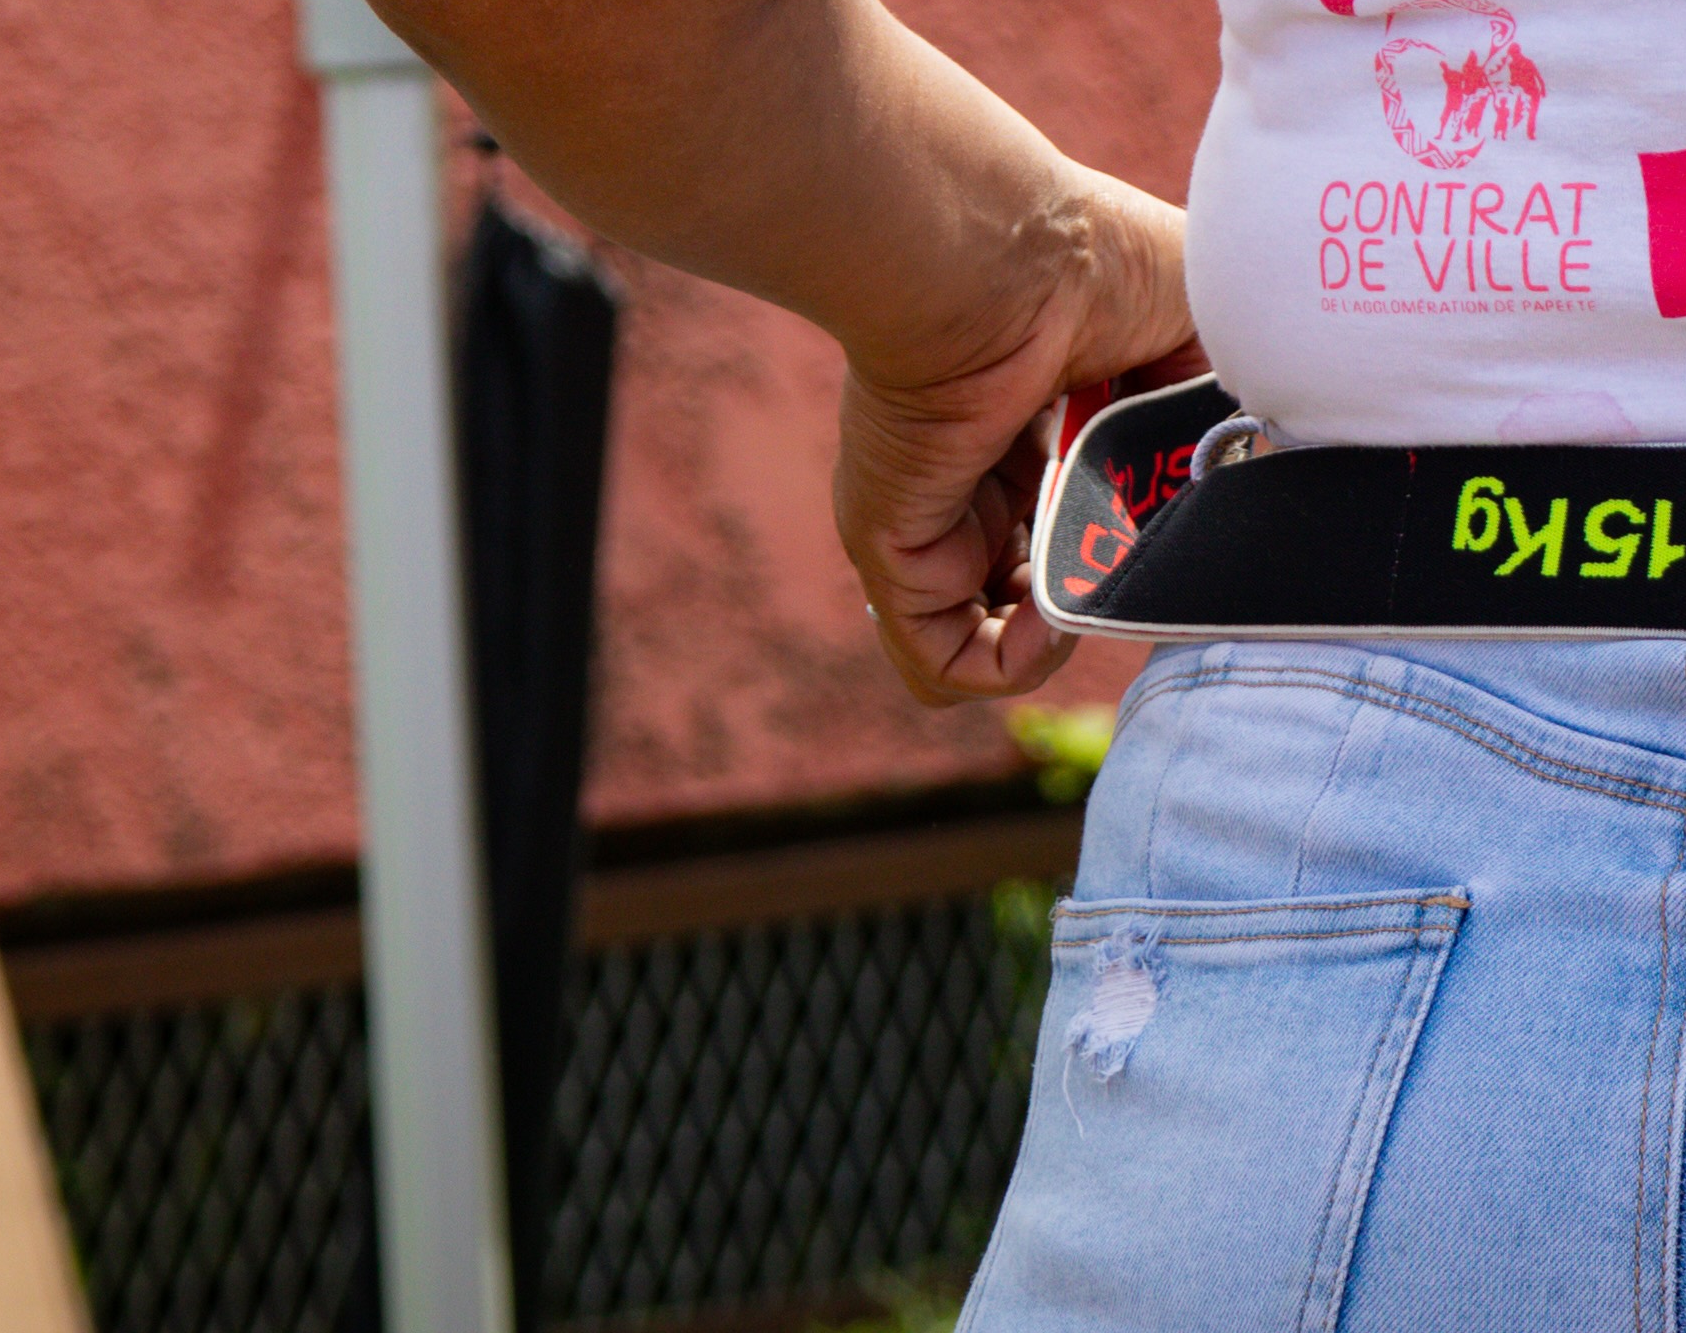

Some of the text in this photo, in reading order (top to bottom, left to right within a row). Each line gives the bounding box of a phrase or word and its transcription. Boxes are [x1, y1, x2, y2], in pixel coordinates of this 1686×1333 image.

[1319, 180, 1598, 236] CONTRAT
[1319, 236, 1593, 294] DE VILLE
[1452, 476, 1686, 579] 15Kg
